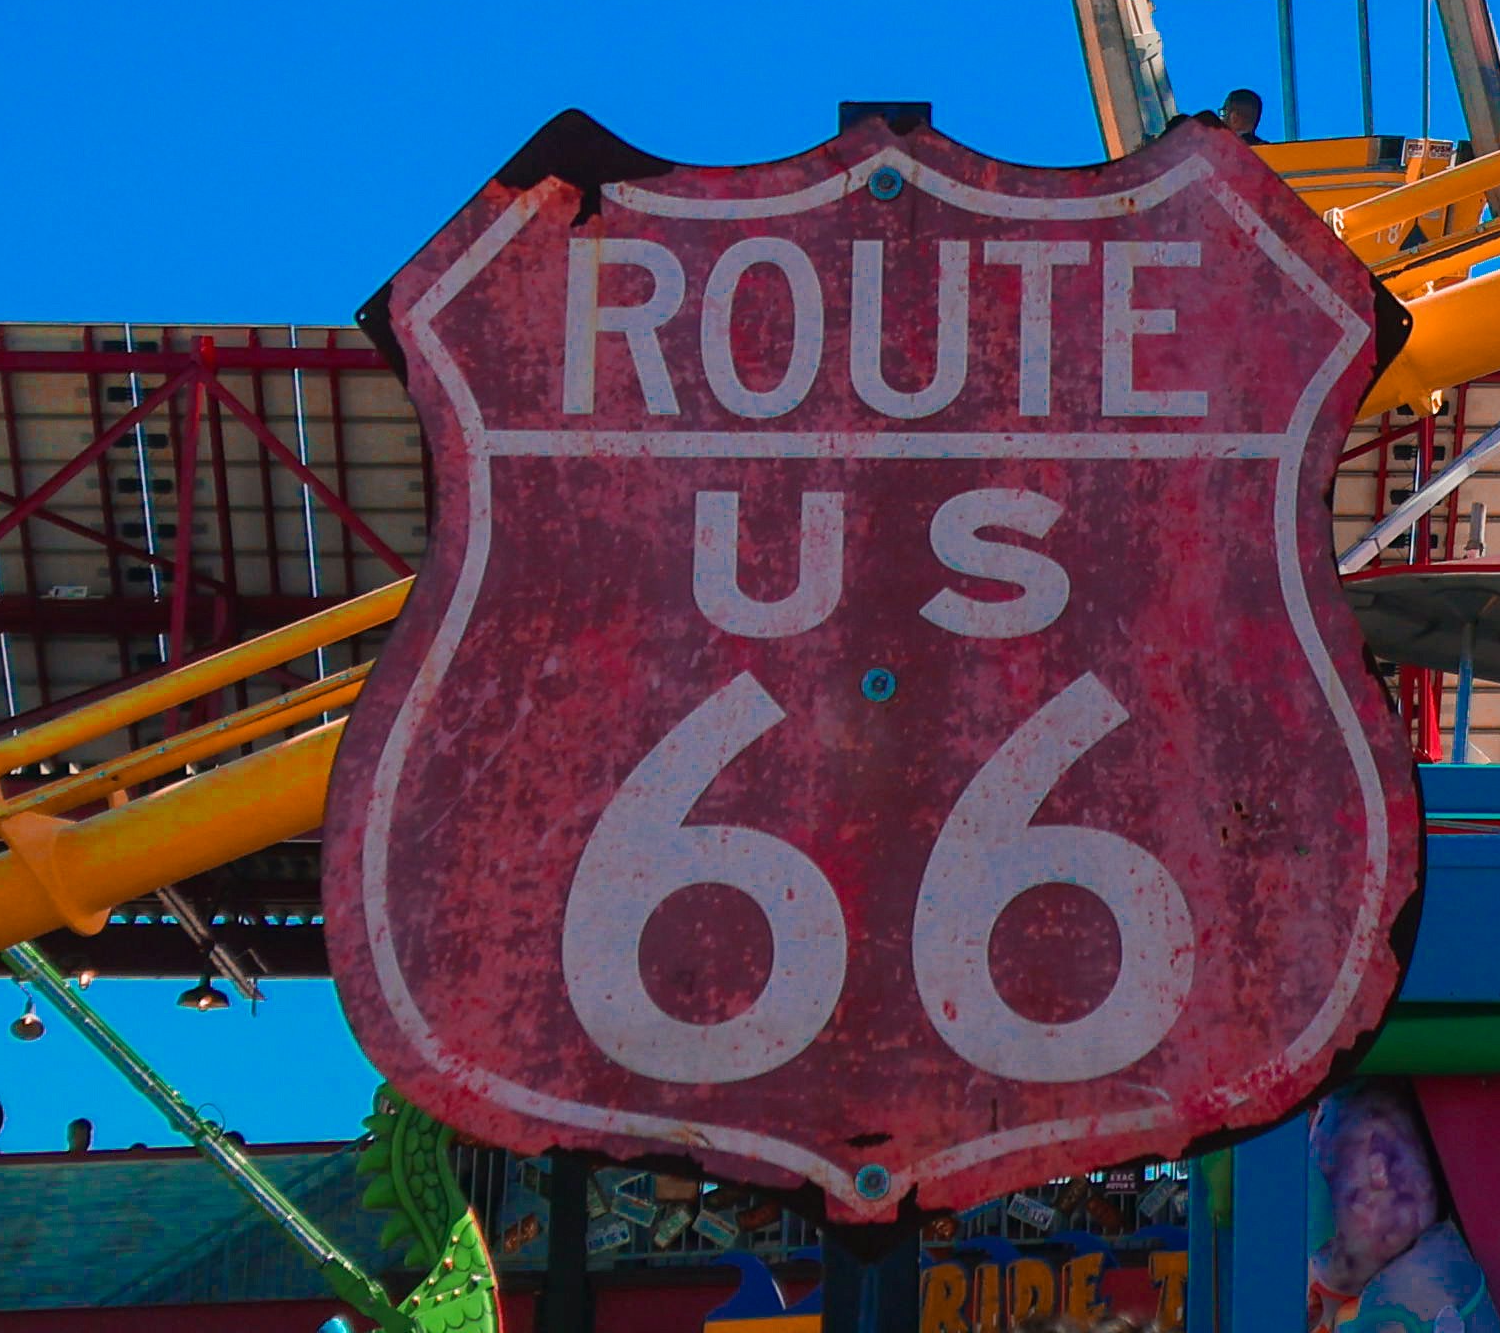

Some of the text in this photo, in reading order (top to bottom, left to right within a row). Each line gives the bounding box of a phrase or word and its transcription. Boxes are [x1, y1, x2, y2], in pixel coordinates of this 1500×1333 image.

[561, 237, 1208, 419] ROUTE
[561, 669, 1196, 1084] 66
[919, 1251, 1106, 1333] RIDE
